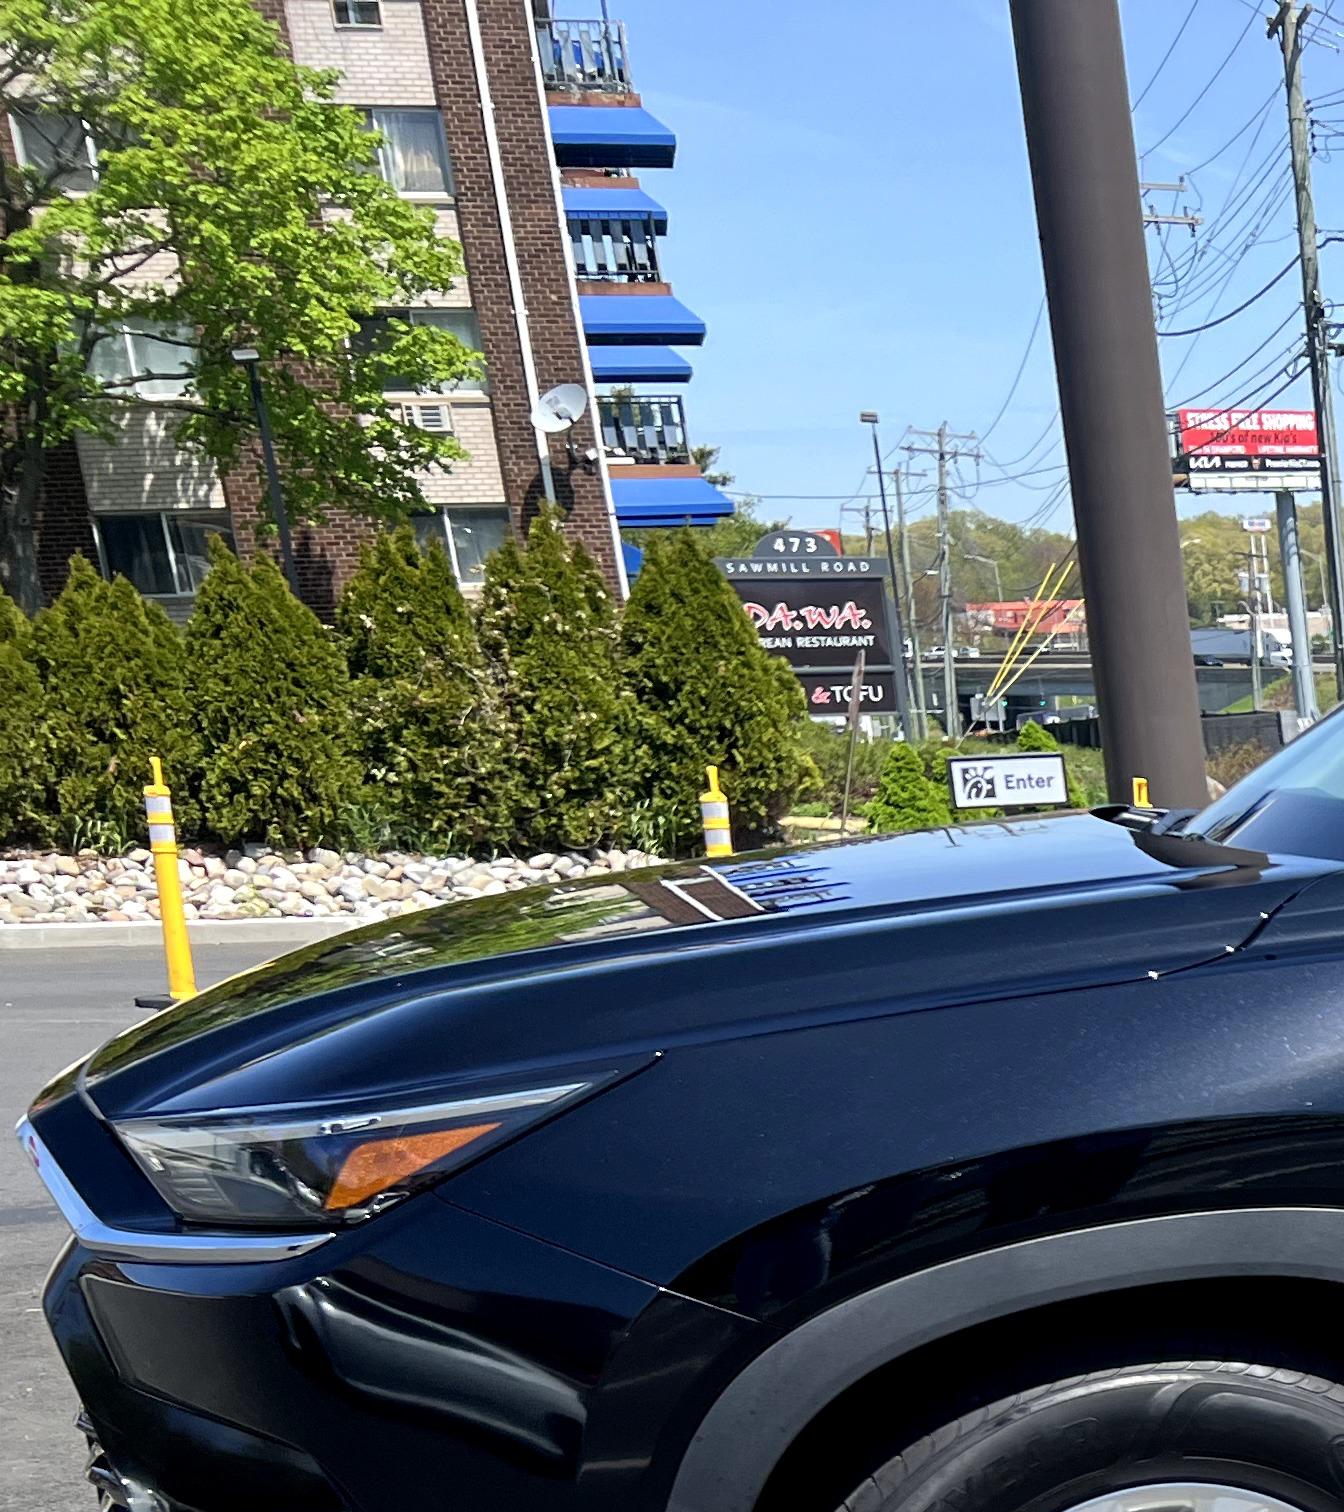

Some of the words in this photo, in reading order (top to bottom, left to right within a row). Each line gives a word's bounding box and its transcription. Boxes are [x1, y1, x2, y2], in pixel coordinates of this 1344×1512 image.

[1261, 413, 1315, 431] SHOPPING
[1238, 432, 1249, 444] of
[1251, 434, 1271, 444] new
[1274, 432, 1297, 444] Kia's
[773, 537, 818, 553] 473
[725, 562, 810, 574] SAWMILL
[821, 561, 871, 573] ROAD
[796, 635, 876, 649] RESTAURANT
[1003, 773, 1056, 790] Enter
